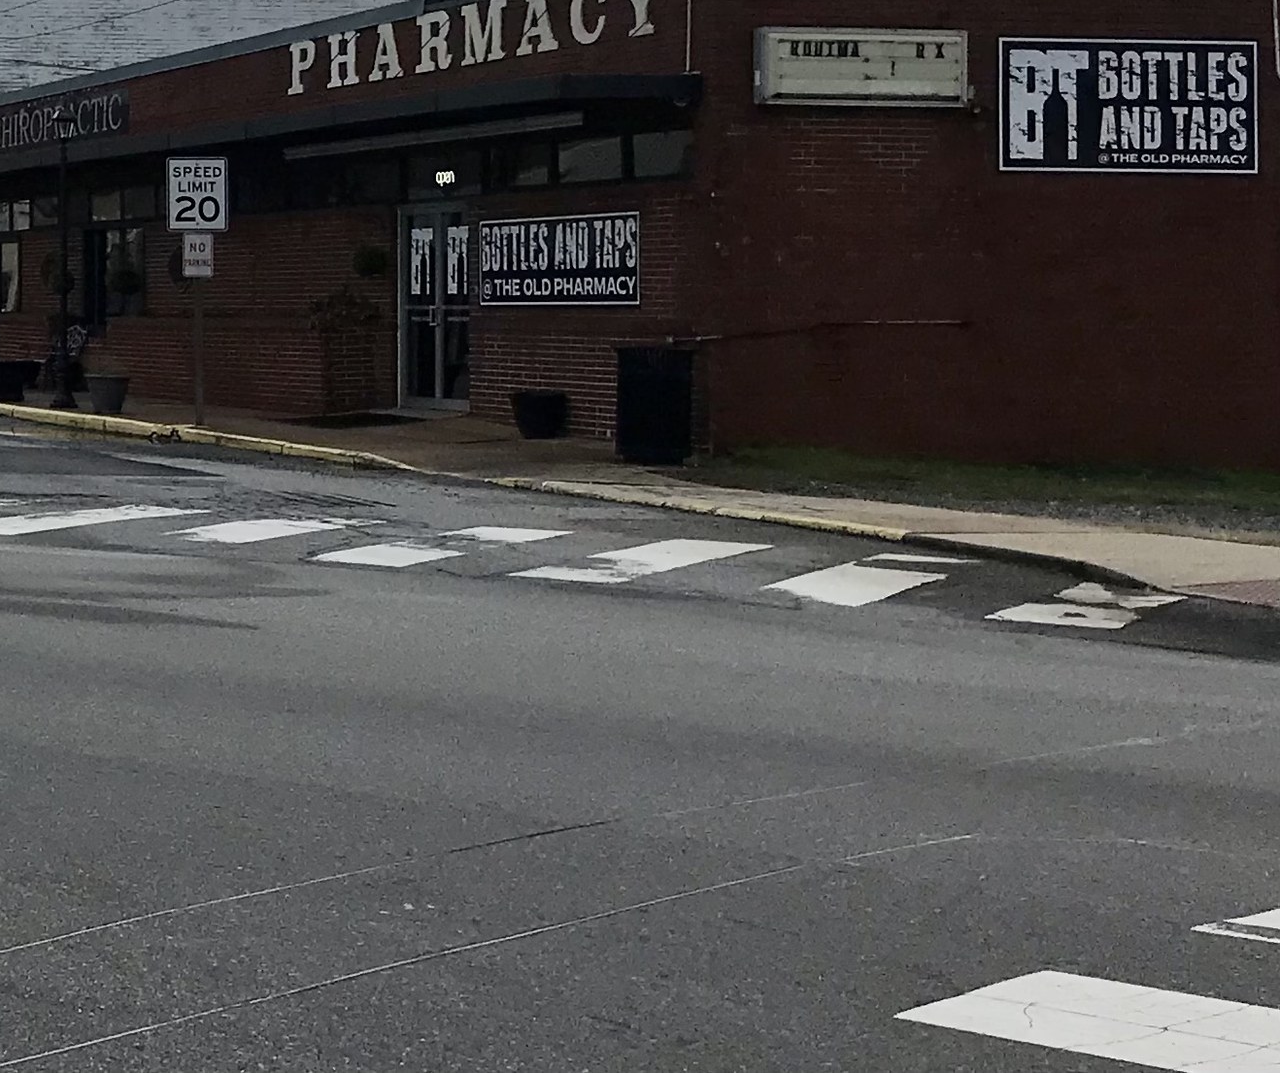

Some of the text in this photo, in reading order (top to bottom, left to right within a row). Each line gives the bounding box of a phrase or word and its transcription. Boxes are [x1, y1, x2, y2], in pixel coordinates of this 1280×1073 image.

[1097, 50, 1249, 102] BOTTLES
[1098, 105, 1247, 151] AND TAPS
[1098, 153, 1249, 164] @ THE OLD PHARMACY
[172, 166, 222, 178] SPEED
[435, 170, 455, 187] open
[177, 181, 217, 193] LIMIT
[175, 195, 221, 222] 20
[189, 242, 206, 253] NO
[481, 223, 548, 272] BOTTLES
[554, 217, 637, 271] AND TAPS
[483, 276, 636, 300] @ THE OLD PHARMACY
